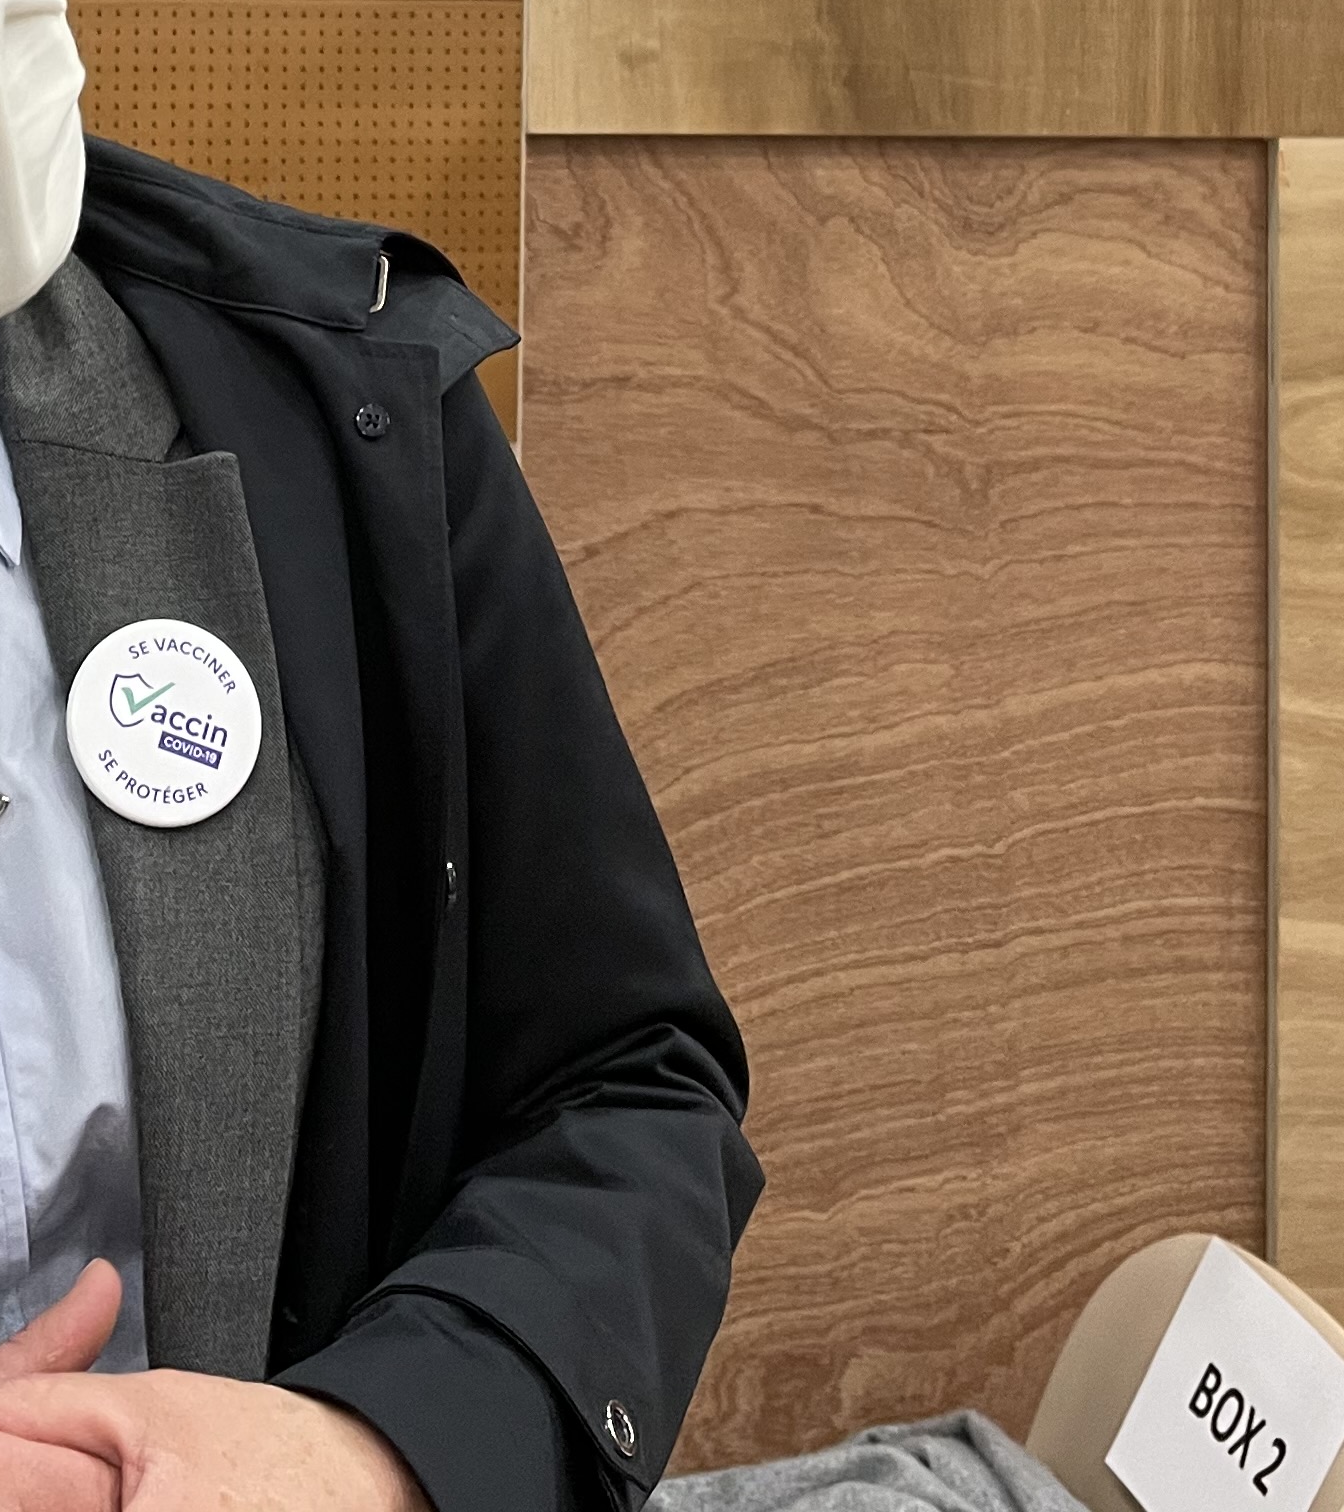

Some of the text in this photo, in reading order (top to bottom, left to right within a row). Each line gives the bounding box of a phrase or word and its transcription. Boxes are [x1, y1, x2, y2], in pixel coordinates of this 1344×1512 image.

[128, 638, 236, 695] SE VACCINER
[98, 749, 209, 805] SE PROTÉGER
[163, 735, 218, 765] COVID-19
[1188, 1362, 1287, 1497] BOX 2
